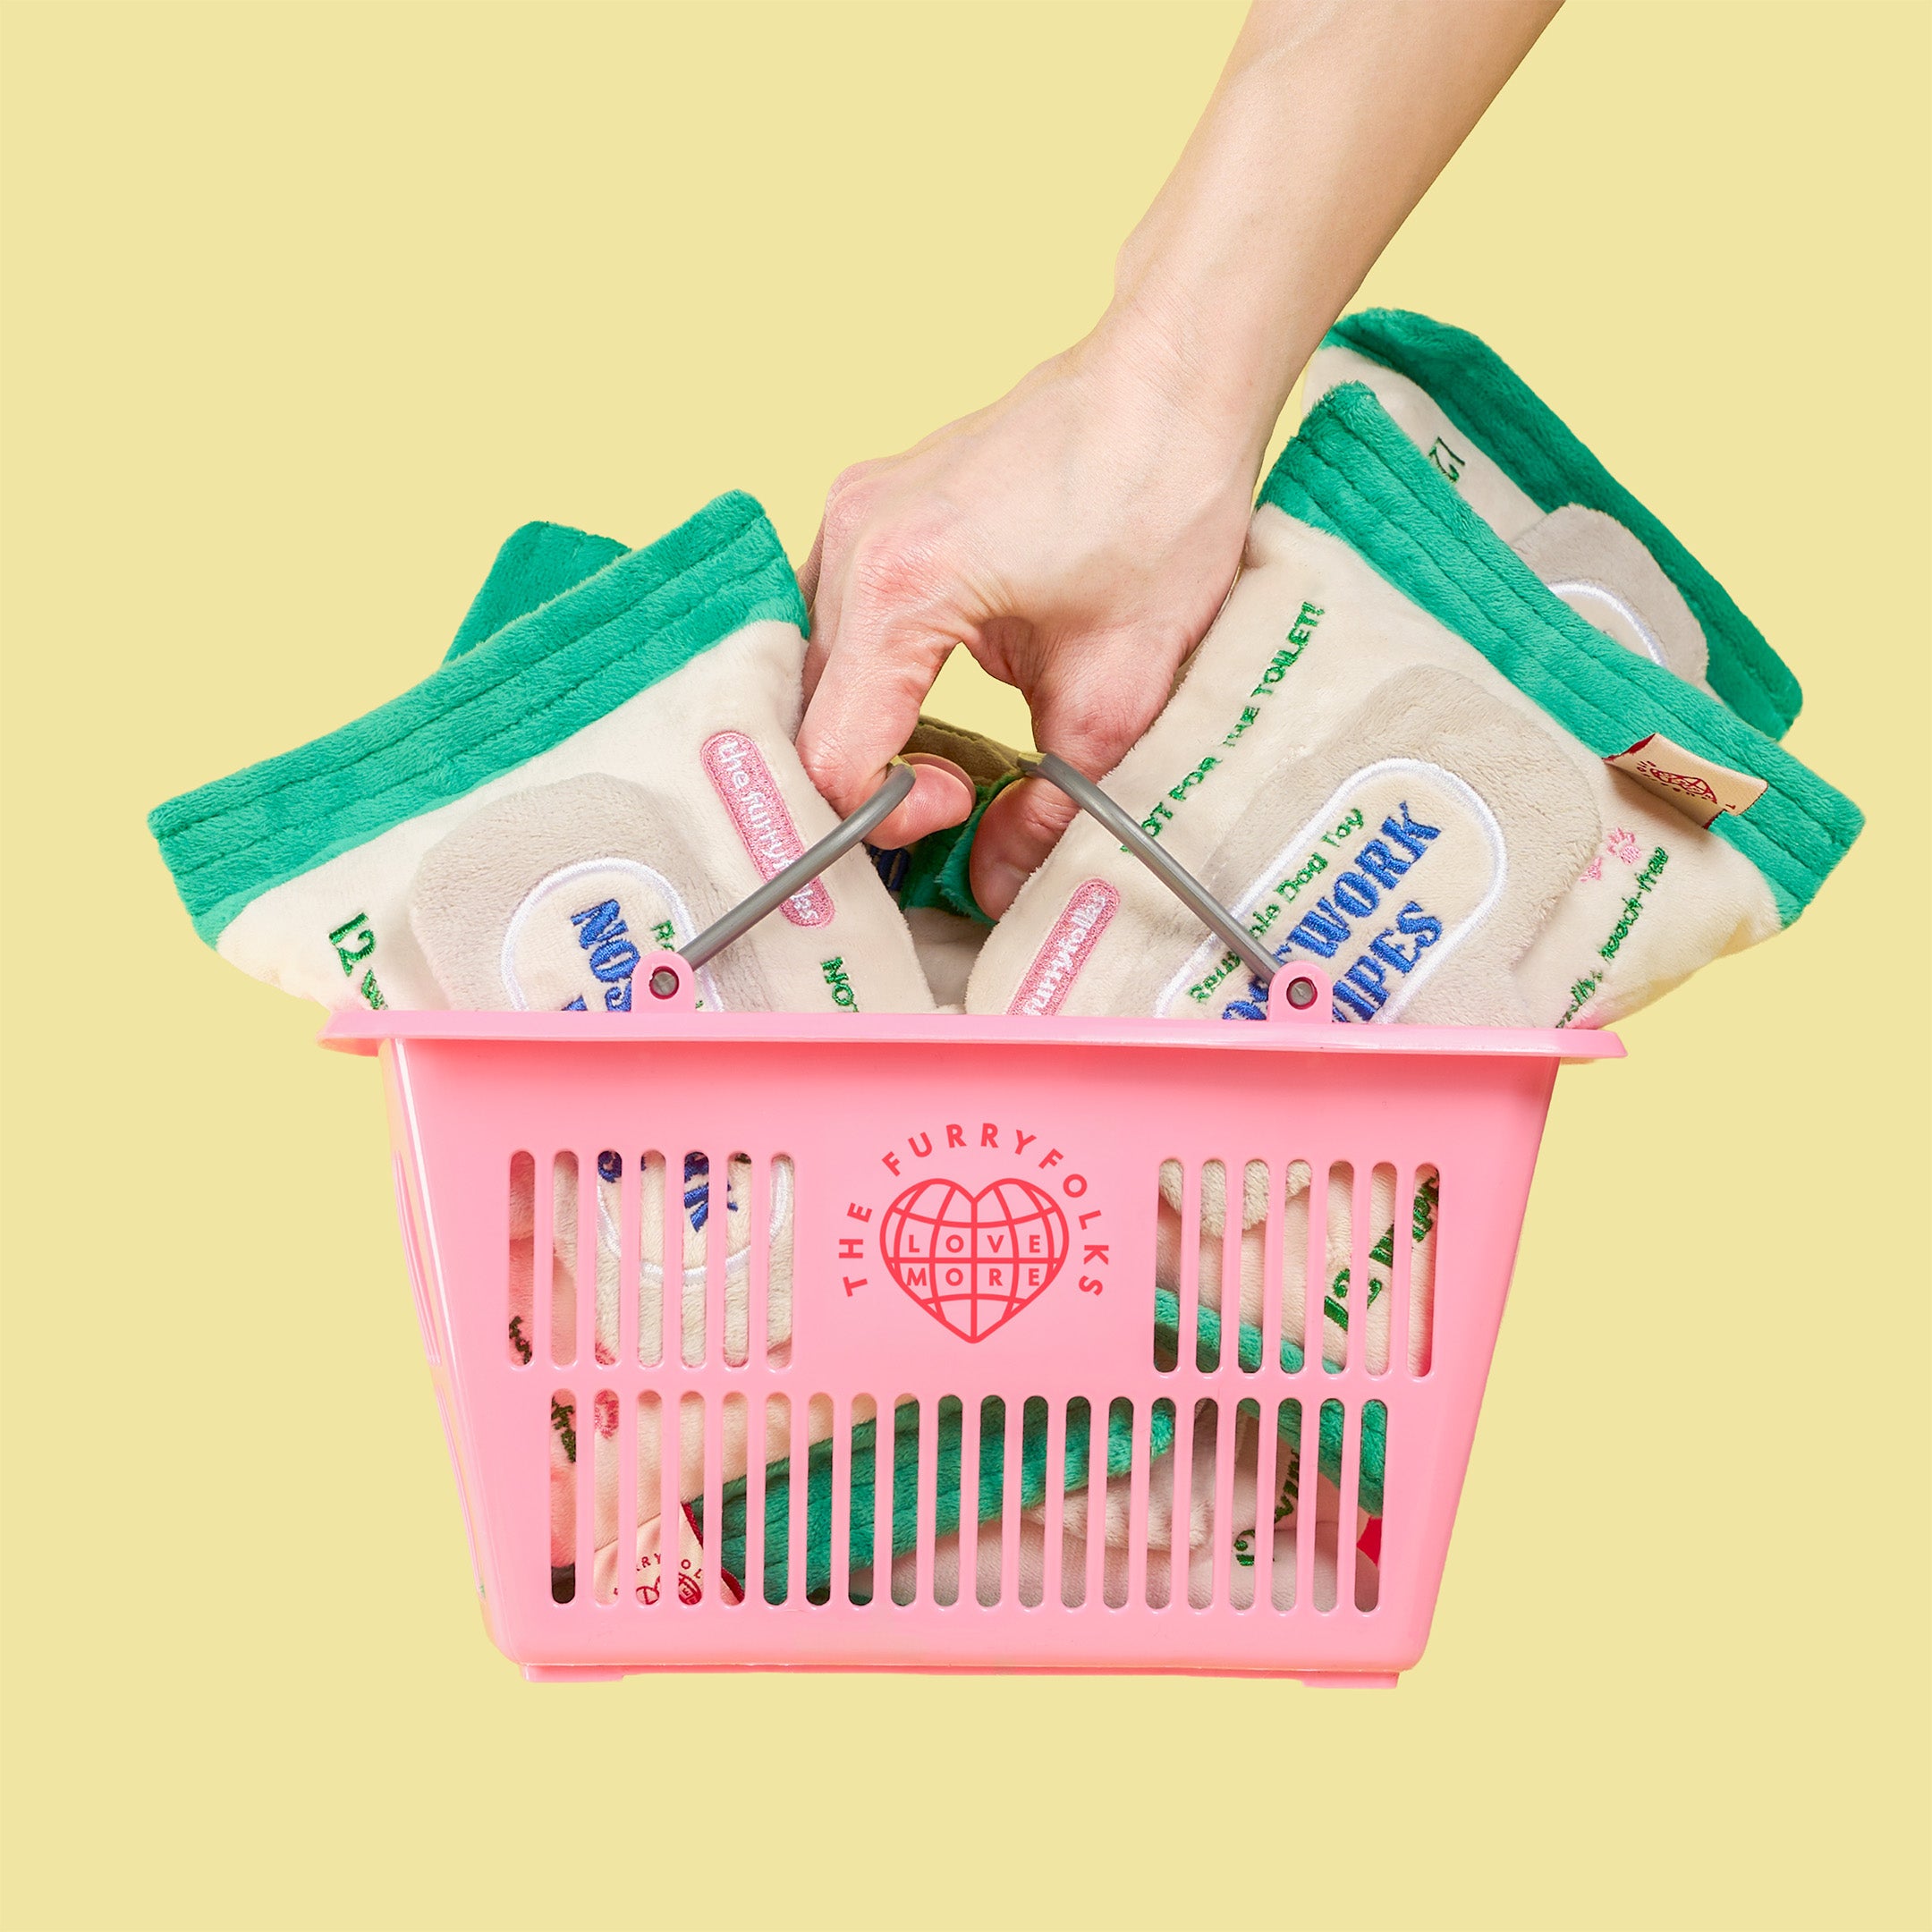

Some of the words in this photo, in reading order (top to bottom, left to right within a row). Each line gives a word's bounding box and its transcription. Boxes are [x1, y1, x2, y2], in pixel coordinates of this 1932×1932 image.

[1120, 801, 1174, 853] OT
[1168, 756, 1224, 801] FOR
[1250, 601, 1326, 699] TOILET!
[717, 740, 750, 790] the
[1320, 807, 1365, 848] Toy
[328, 911, 376, 978] 12
[1332, 900, 1444, 1024] IPES
[820, 955, 860, 1013] NO
[838, 1201, 874, 1298] THE
[881, 1123, 1109, 1297] FURRYFOLKS
[908, 1234, 1041, 1253] LOVE
[906, 1267, 1041, 1286] MORE
